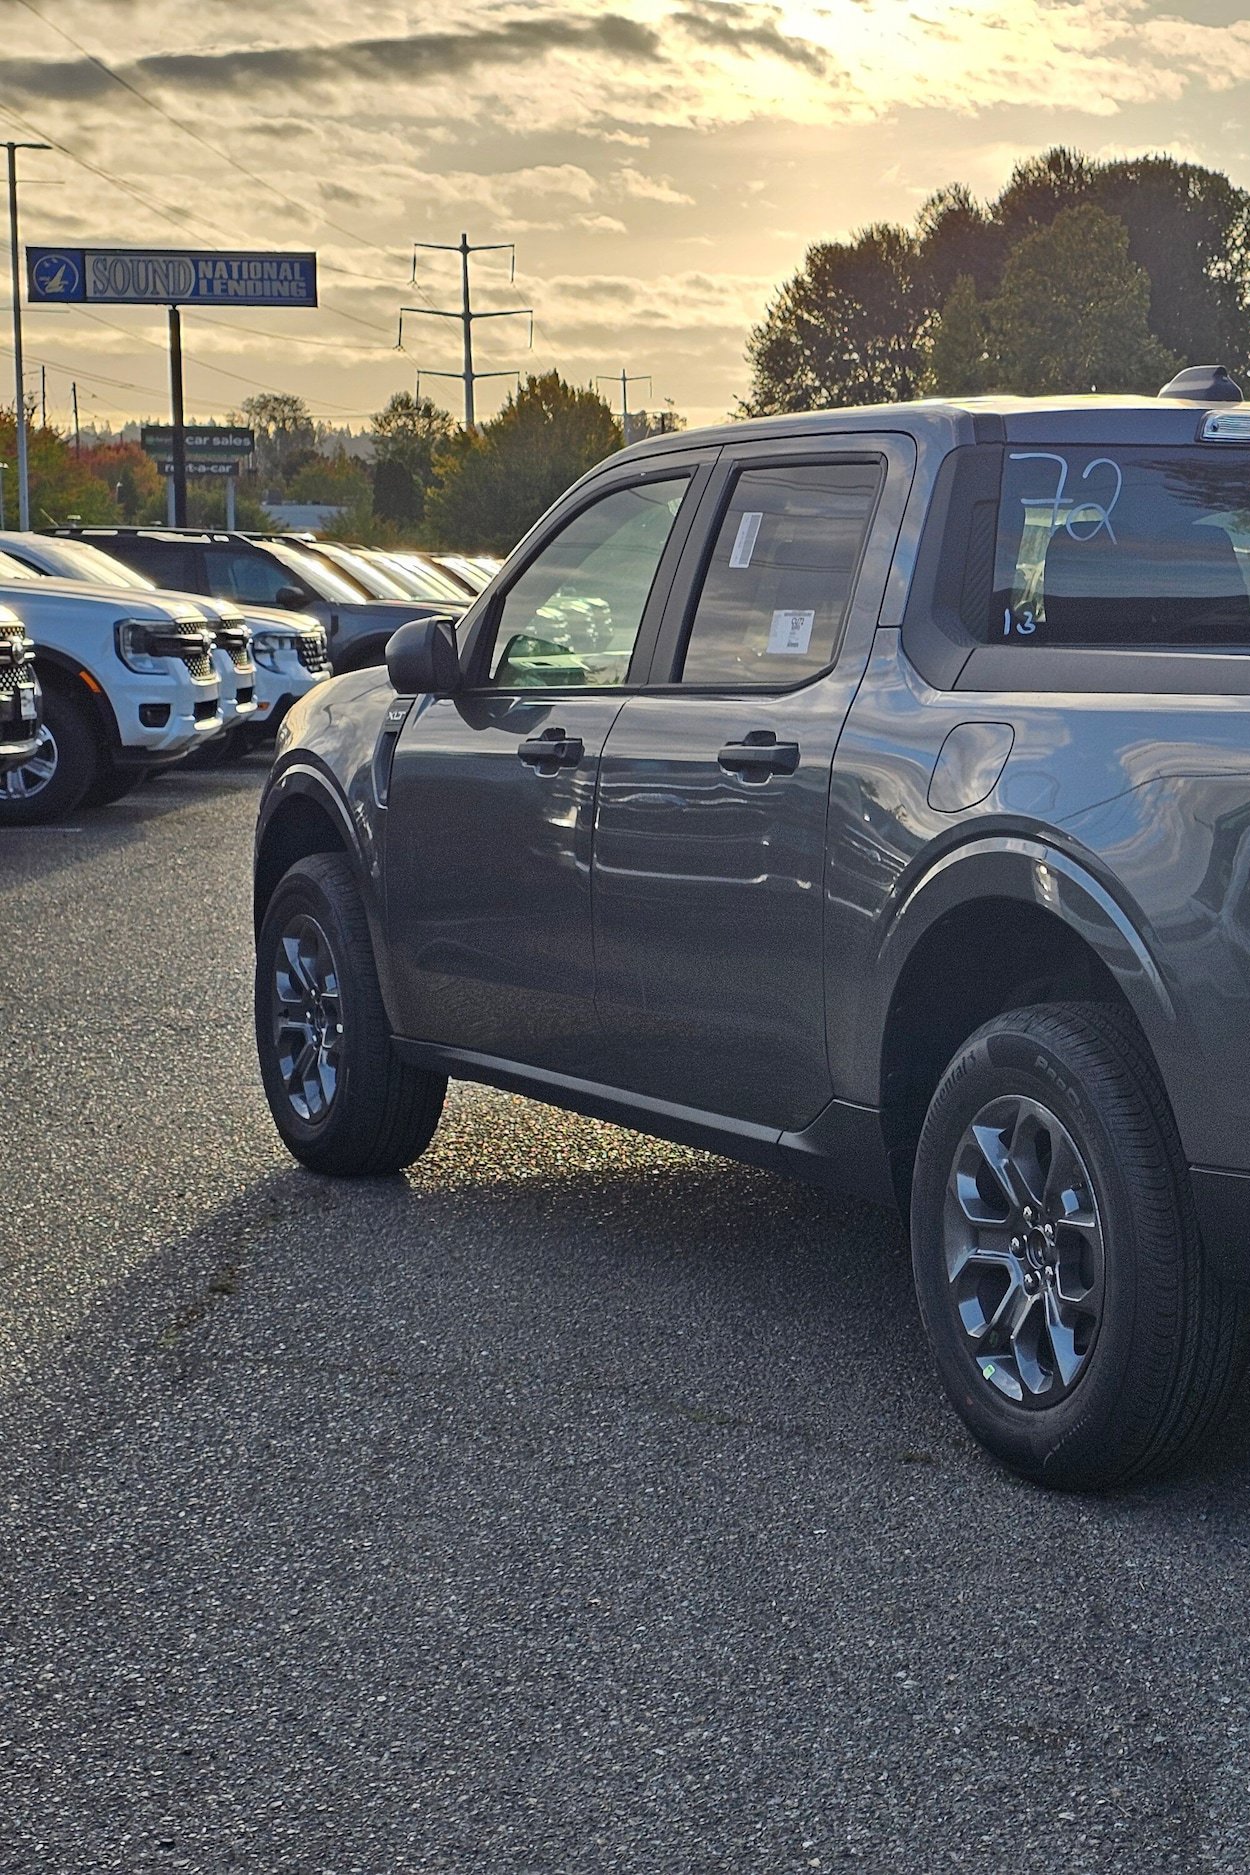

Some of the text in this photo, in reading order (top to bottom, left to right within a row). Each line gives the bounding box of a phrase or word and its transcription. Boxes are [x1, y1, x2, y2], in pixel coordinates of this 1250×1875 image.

[92, 256, 192, 297] SOUND
[199, 260, 305, 281] NATIONAL
[200, 279, 307, 298] LENDING
[185, 435, 209, 446] car
[212, 434, 251, 447] sales
[164, 463, 232, 473] rt-a-car
[1009, 452, 1123, 545] 72
[1003, 608, 1036, 636] 13
[388, 711, 407, 721] XLT
